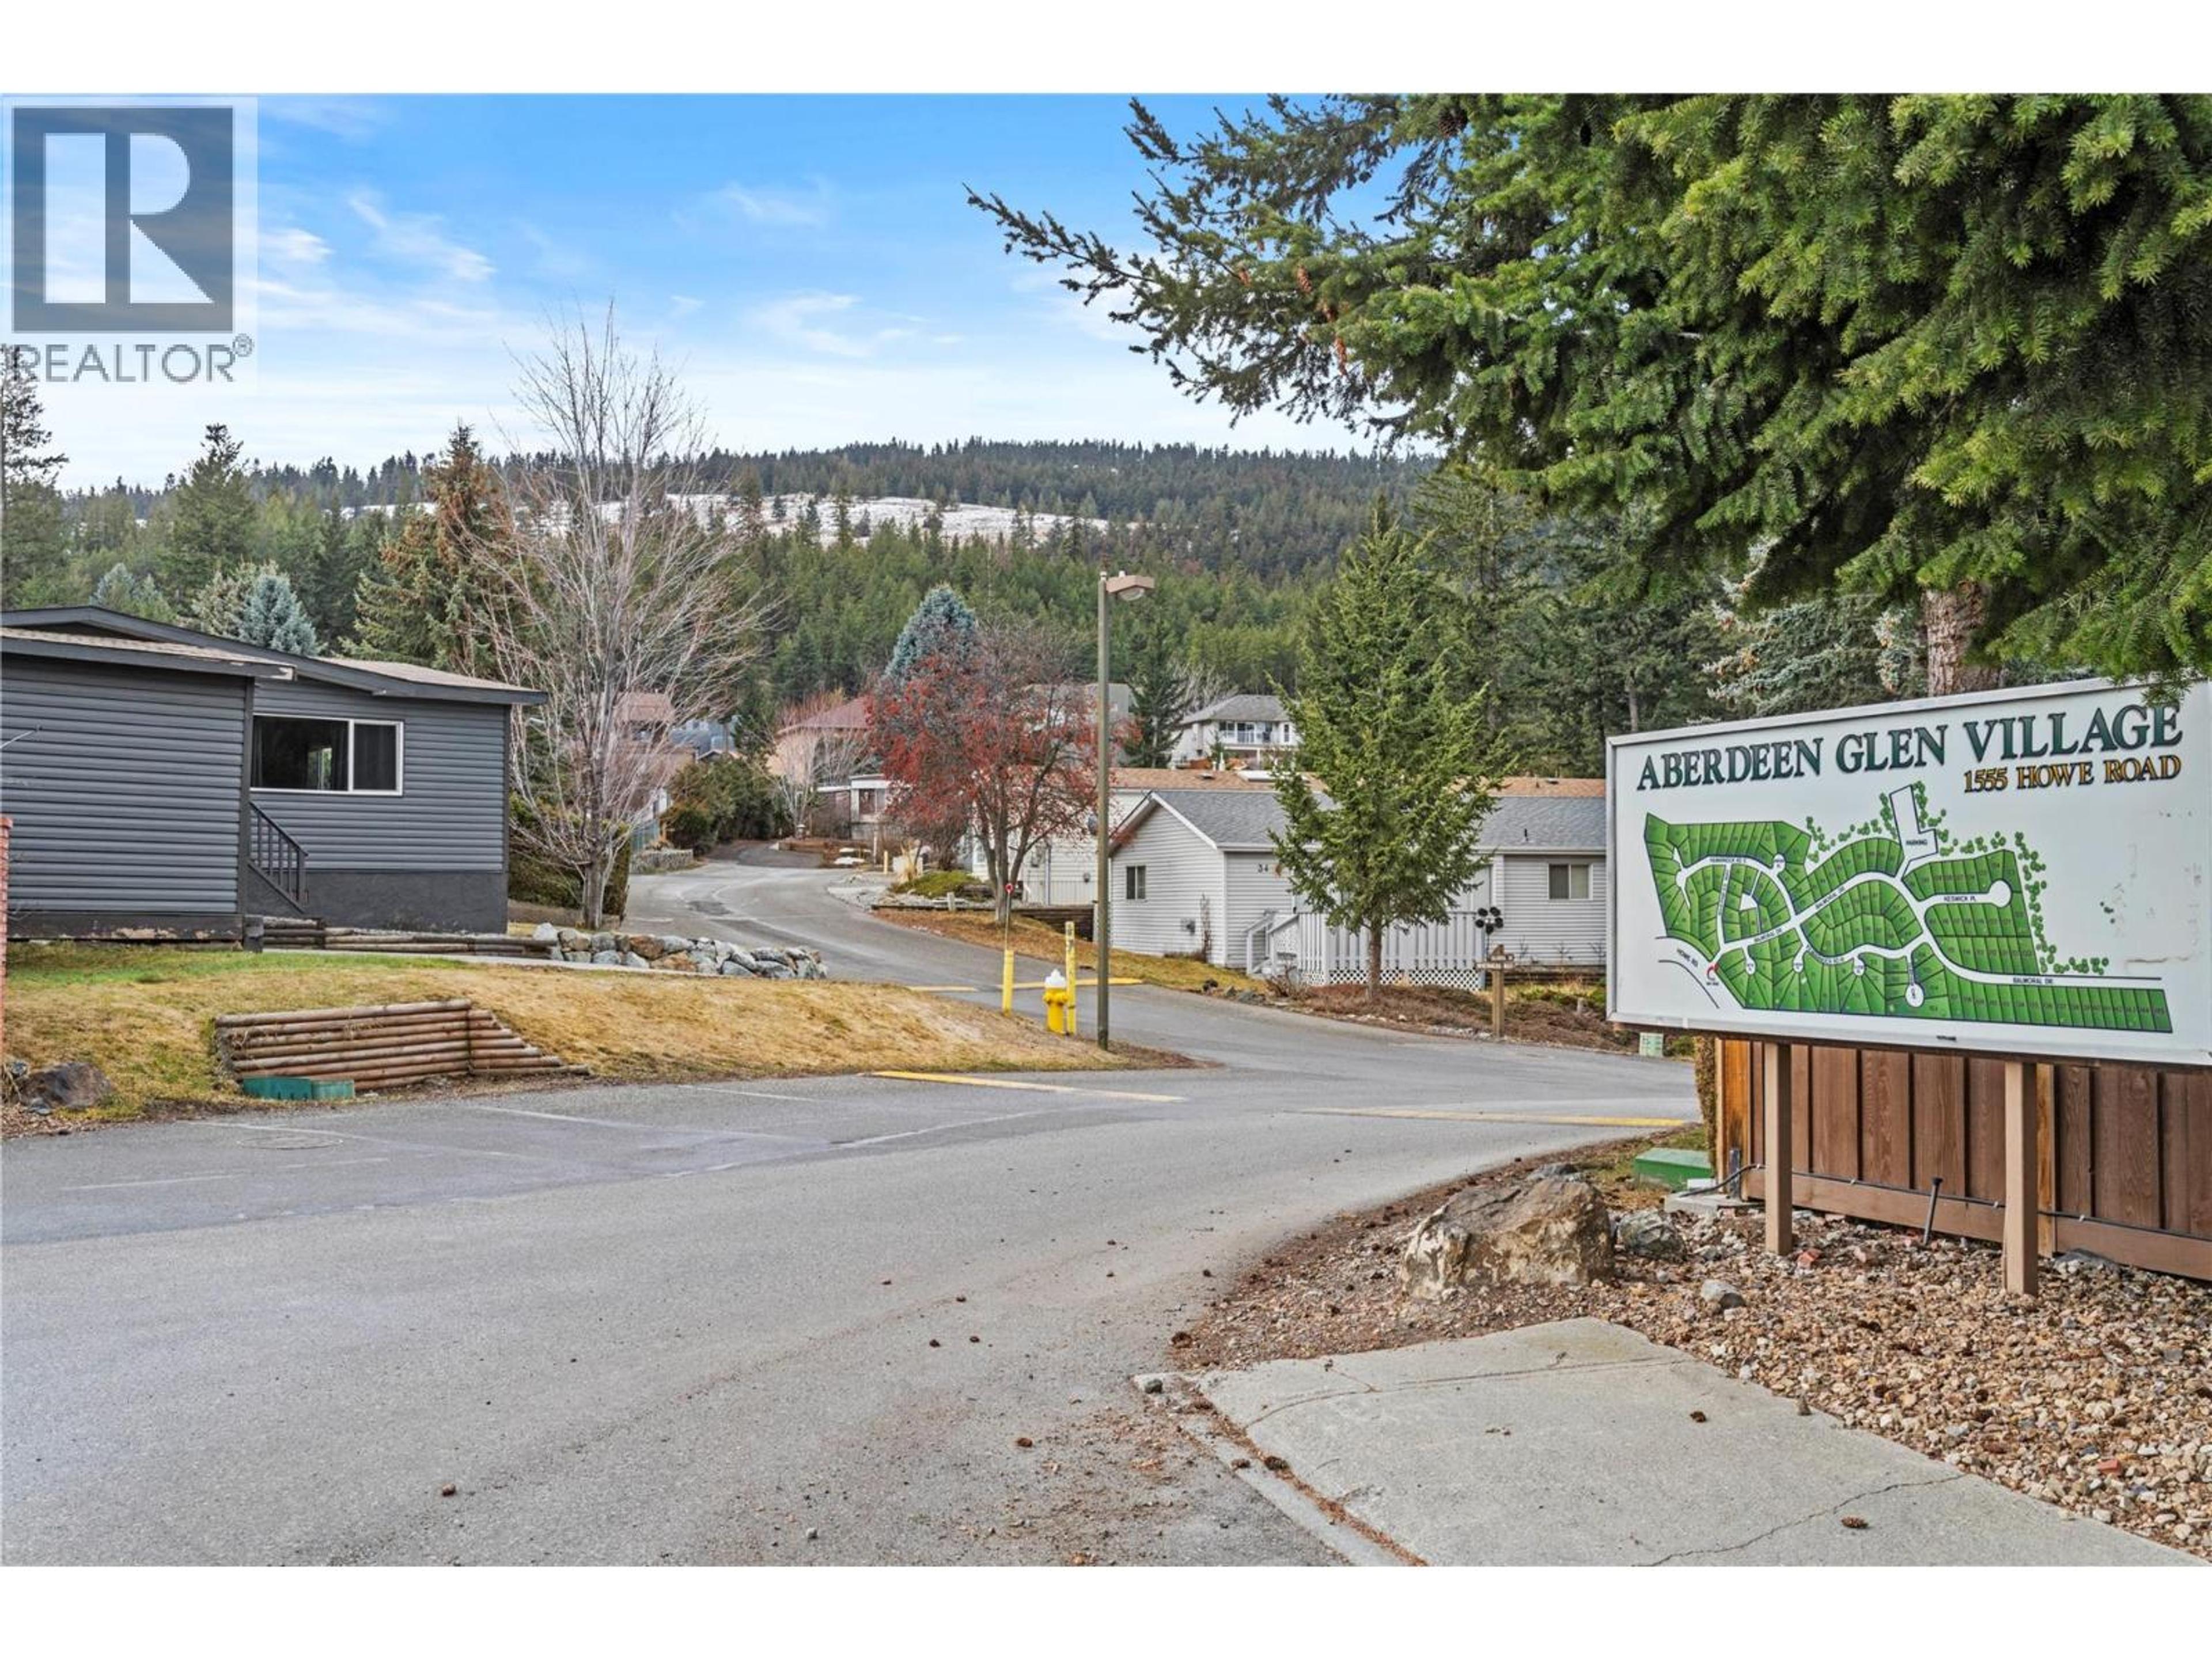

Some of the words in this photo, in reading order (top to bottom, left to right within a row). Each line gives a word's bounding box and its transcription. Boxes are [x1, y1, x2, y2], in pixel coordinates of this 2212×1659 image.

[1637, 737, 1824, 791] ABERDEEN
[1835, 725, 1948, 774] GLEN
[1963, 702, 2183, 762] VILLAGE
[1964, 767, 2008, 793] 1555
[2016, 762, 2094, 789] HOWE
[2104, 754, 2182, 783] ROAD
[1816, 892, 1838, 910] BALMORAL
